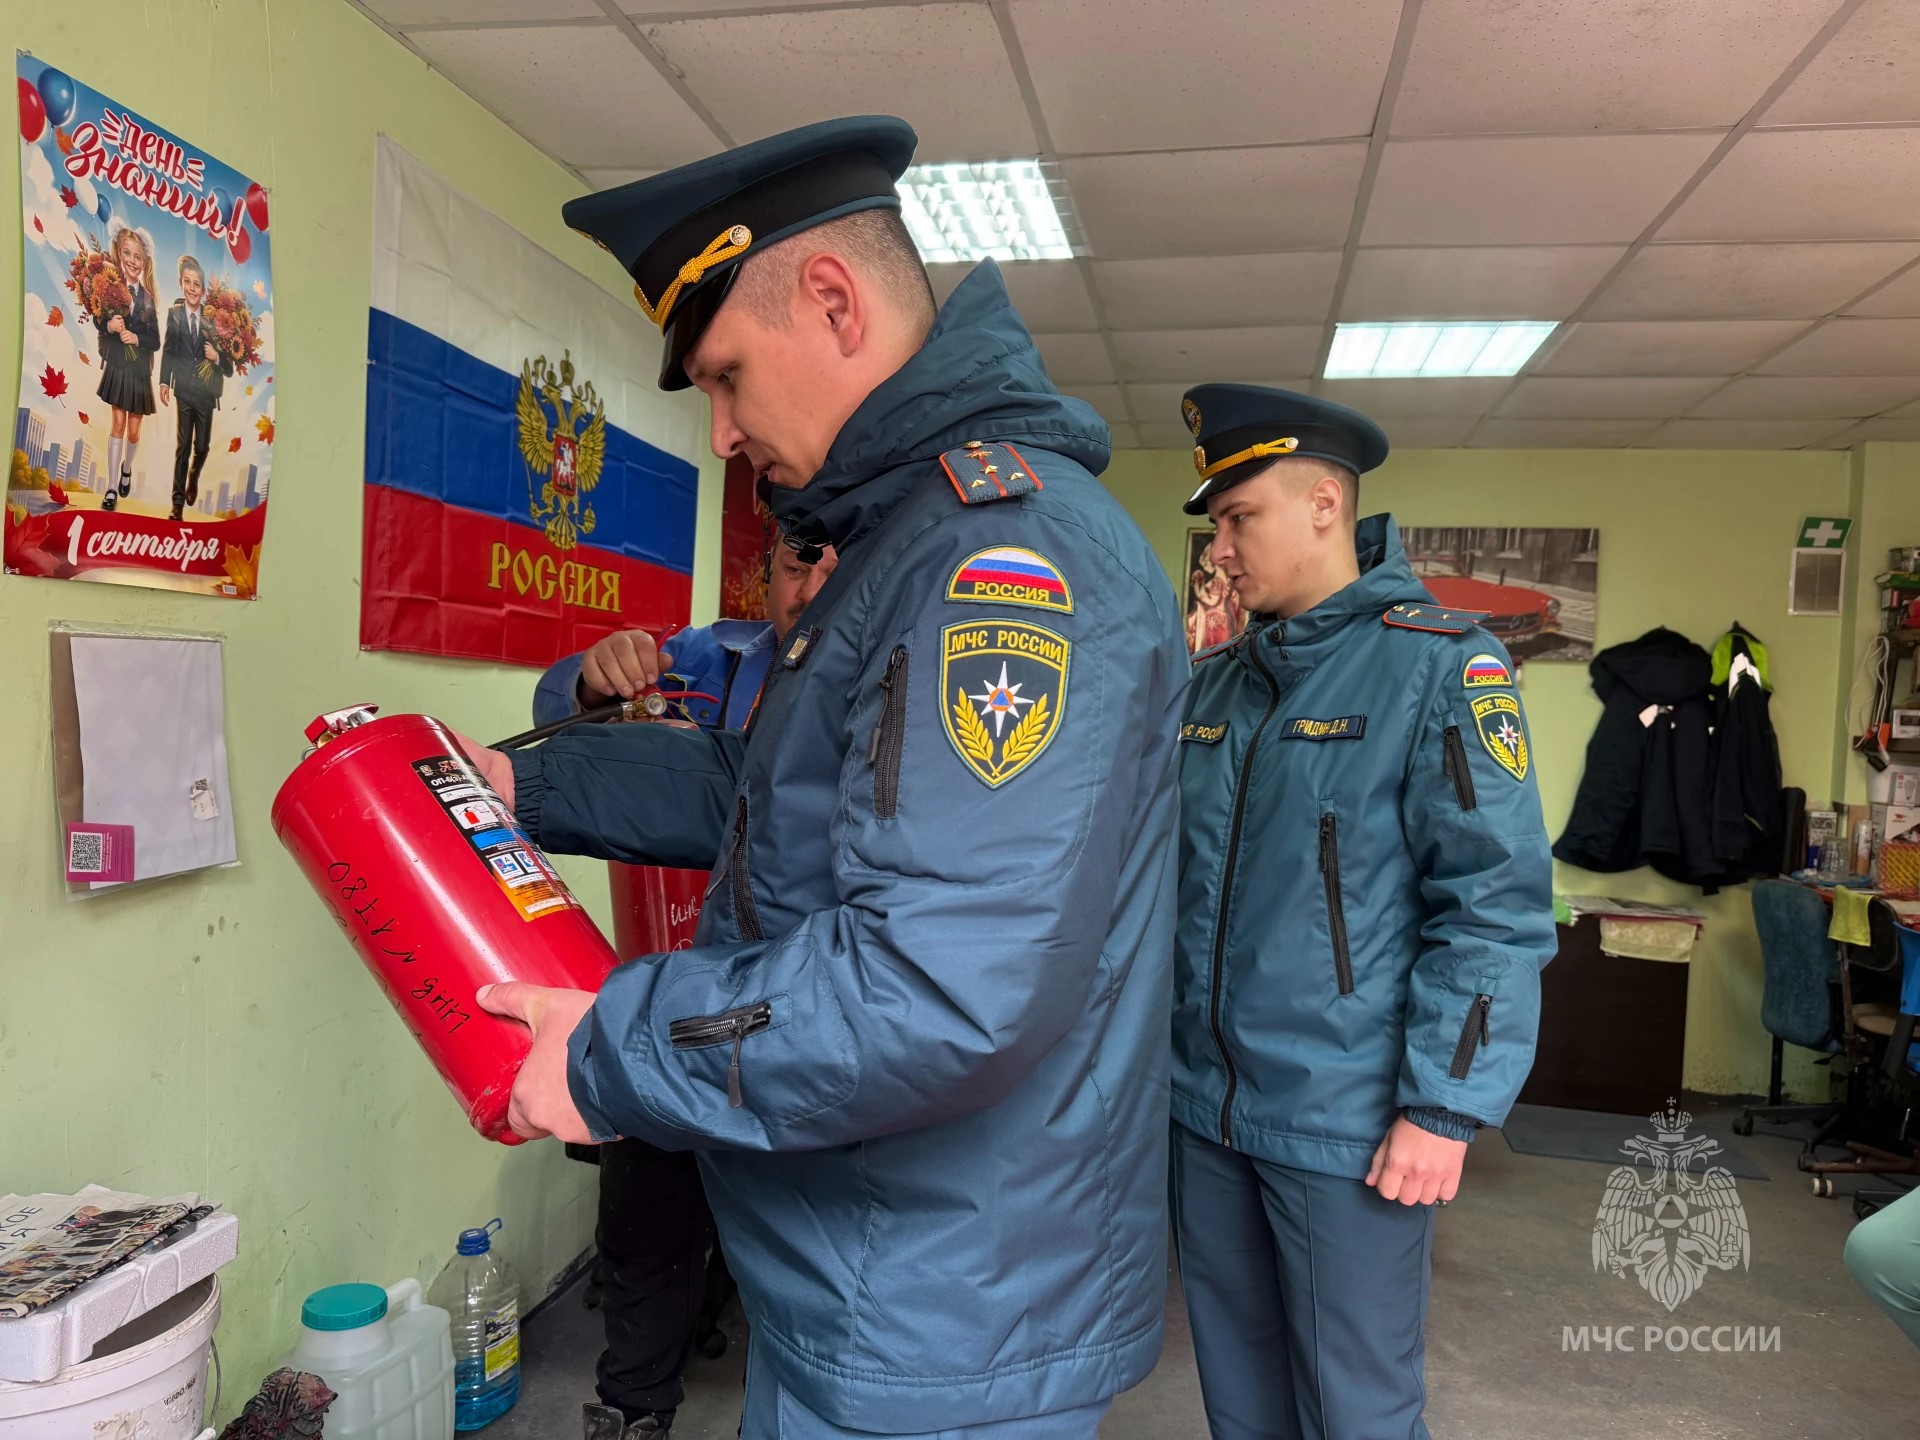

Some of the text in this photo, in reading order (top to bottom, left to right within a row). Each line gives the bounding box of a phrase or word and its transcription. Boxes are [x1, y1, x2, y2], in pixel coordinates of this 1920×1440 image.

[64, 122, 247, 246] Знаний!
[67, 514, 220, 572] 1 сентября
[488, 542, 622, 613] РОССИЯ
[973, 582, 1050, 602] РОССИЯ
[951, 630, 1063, 662] МЧС РОССИИ
[1473, 675, 1505, 684] РОССИЯ
[1475, 700, 1494, 714] МЧС
